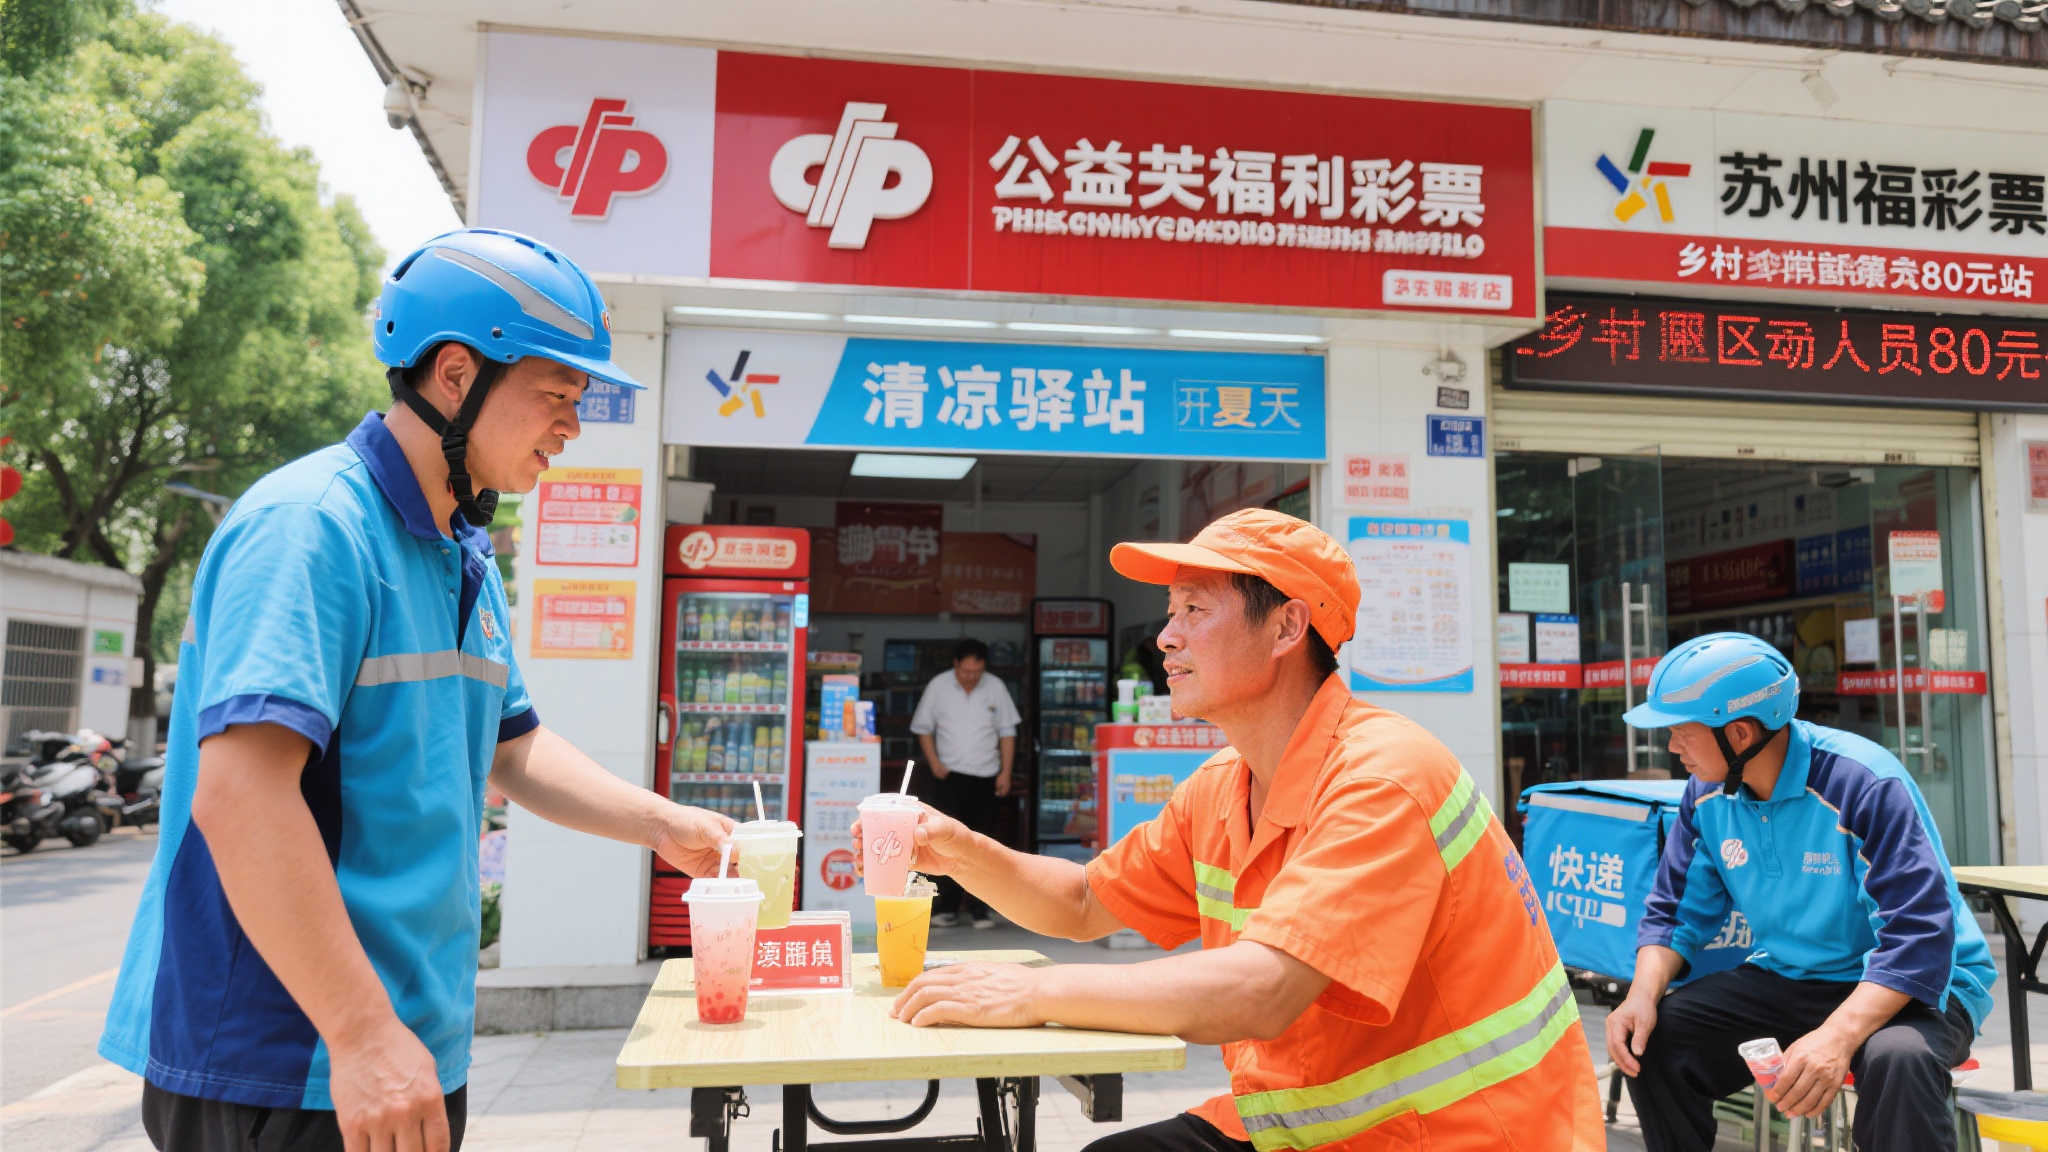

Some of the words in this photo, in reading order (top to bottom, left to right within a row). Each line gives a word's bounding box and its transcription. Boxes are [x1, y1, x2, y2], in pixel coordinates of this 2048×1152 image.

[1720, 152, 2047, 235] 苏州福彩票
[862, 361, 1147, 435] 清凉驿站
[1179, 386, 1301, 428] 开夏天
[1548, 844, 1625, 899] 快递
